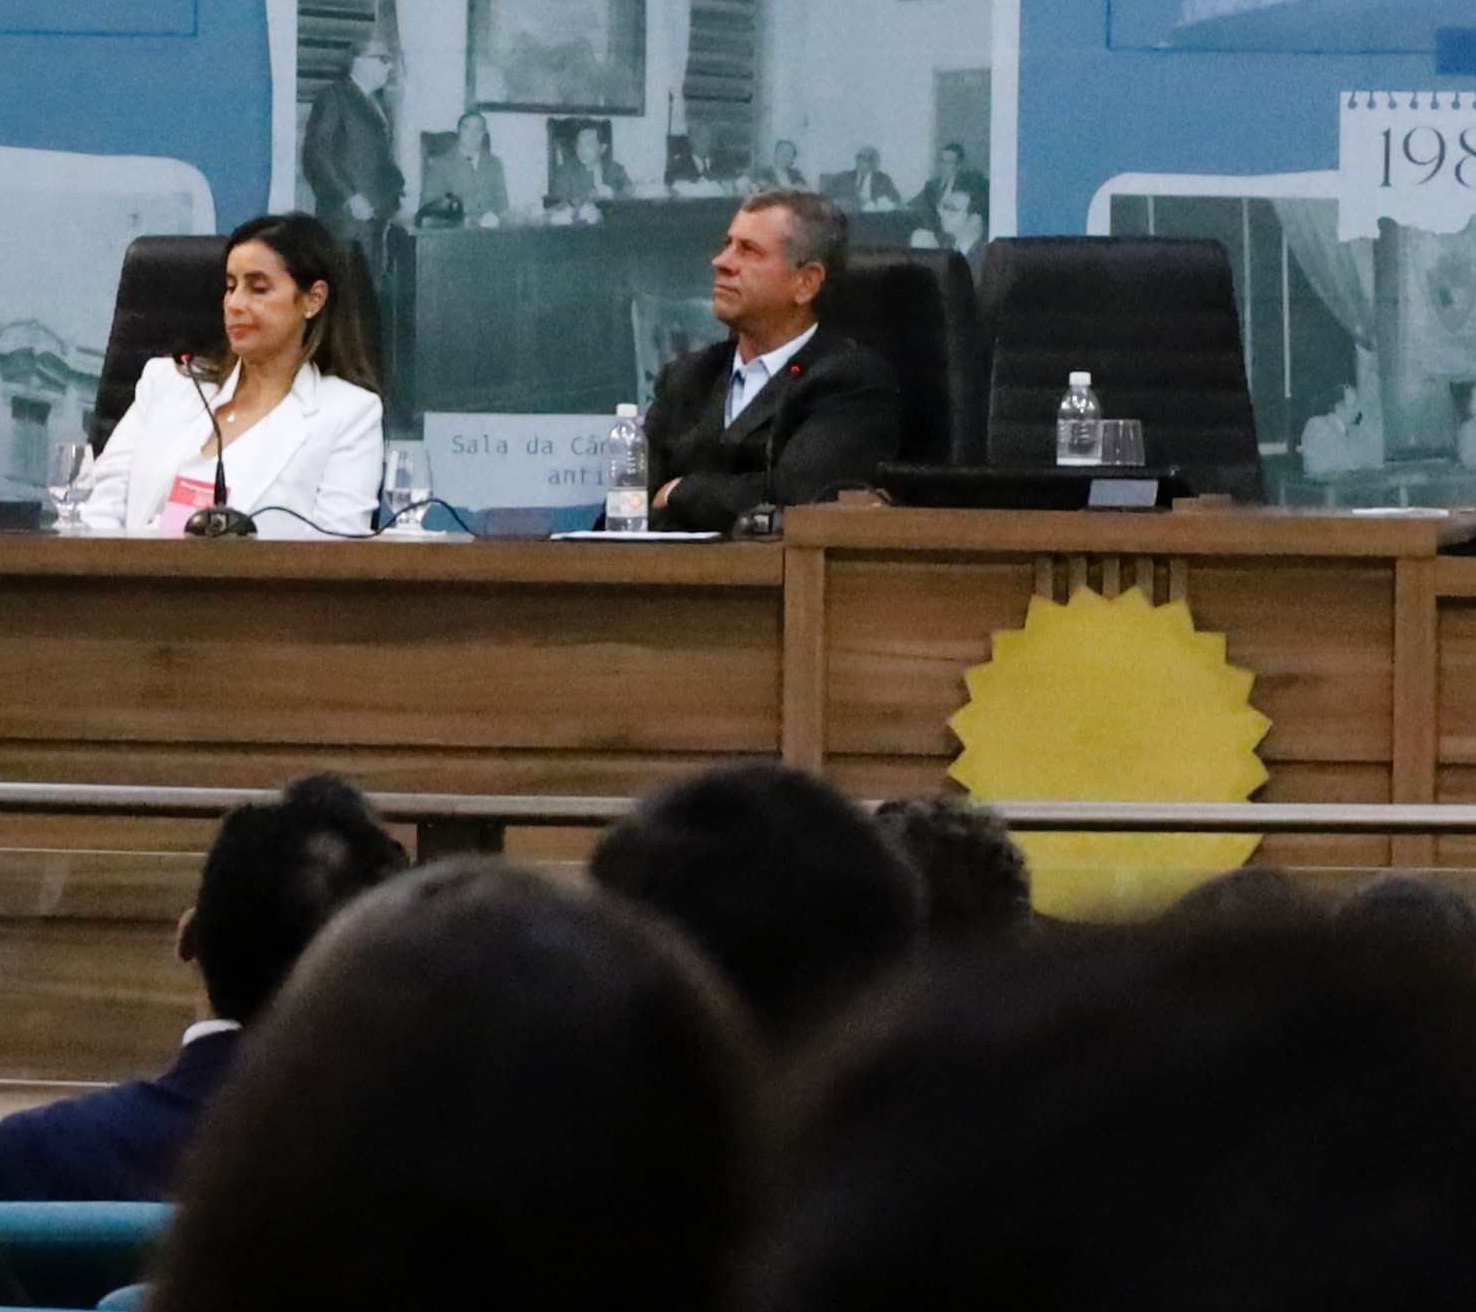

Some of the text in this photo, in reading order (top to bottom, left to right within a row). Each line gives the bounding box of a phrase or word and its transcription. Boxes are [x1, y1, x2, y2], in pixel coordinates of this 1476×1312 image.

[452, 434, 508, 455] Sala
[526, 435, 554, 455] da
[548, 467, 605, 486] anti
